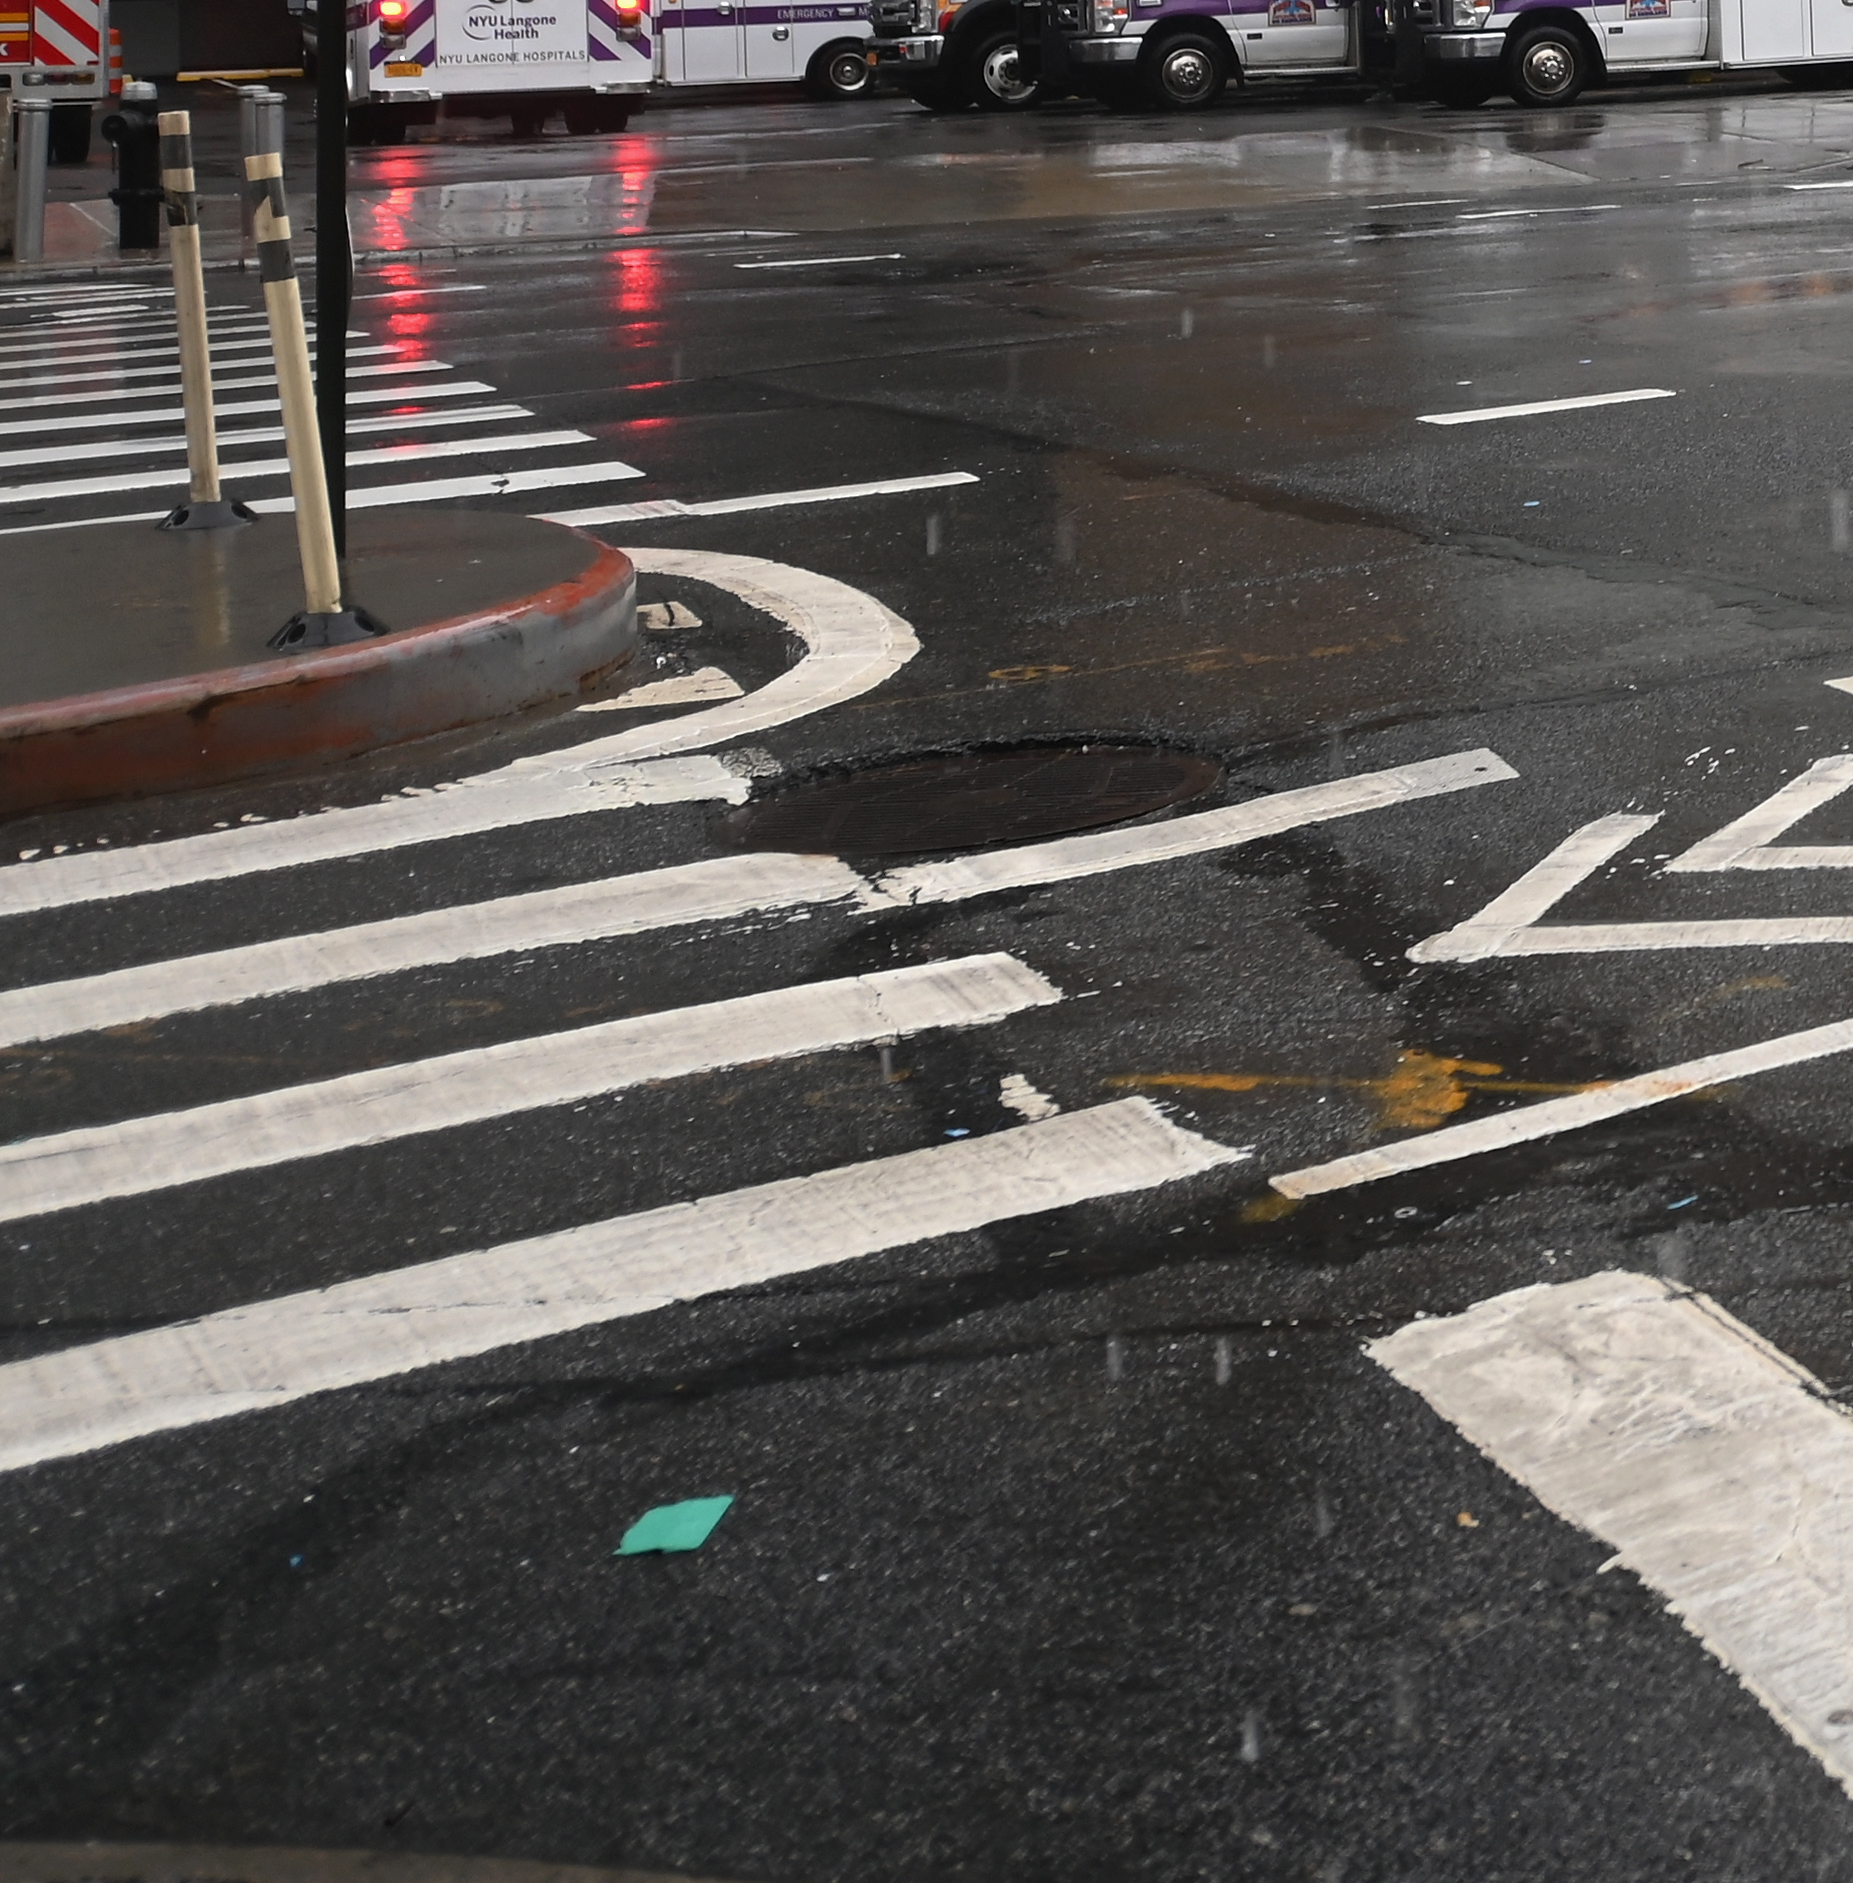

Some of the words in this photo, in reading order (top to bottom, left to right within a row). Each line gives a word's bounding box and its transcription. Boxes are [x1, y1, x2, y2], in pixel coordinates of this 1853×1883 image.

[777, 9, 834, 20] EMERGENCY
[468, 15, 498, 28] NYU
[500, 14, 557, 31] Langone
[494, 27, 540, 41] Health
[439, 53, 467, 65] NYU
[468, 52, 520, 64] LANGONE
[523, 50, 586, 63] HOSPITALS
